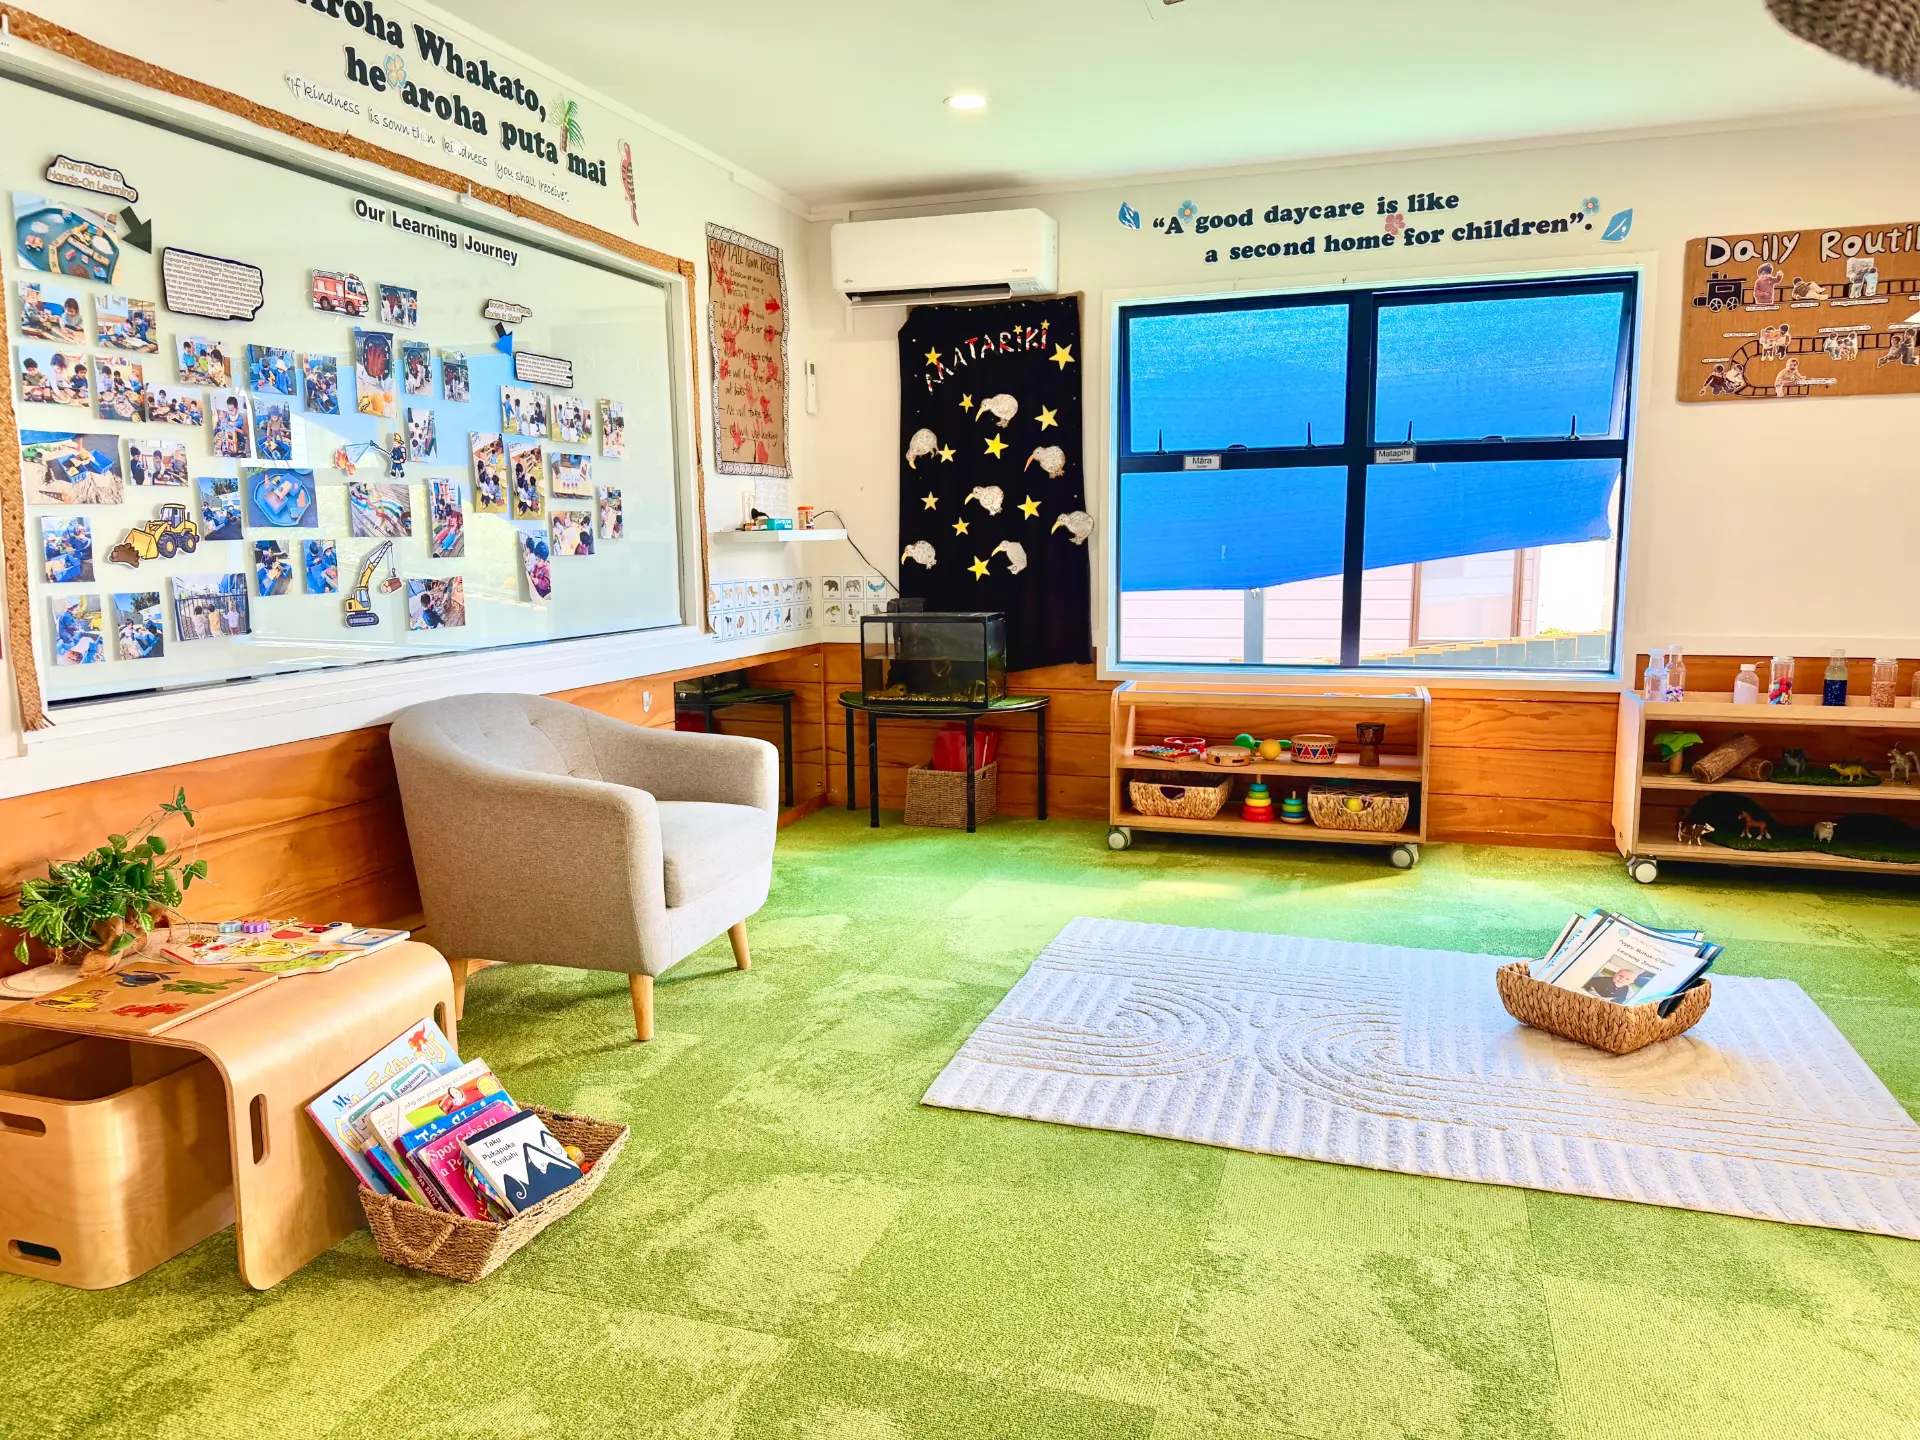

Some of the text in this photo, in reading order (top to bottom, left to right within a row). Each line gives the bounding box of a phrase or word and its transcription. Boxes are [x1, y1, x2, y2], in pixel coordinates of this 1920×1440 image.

[296, 0, 547, 122] roha Whakato,
[345, 46, 607, 187] he aroha puta mai
[303, 82, 360, 115] kindness
[369, 108, 380, 125] is
[382, 117, 410, 135] sown
[443, 137, 488, 167] kidness
[496, 163, 514, 179] you
[515, 170, 536, 188] shall
[58, 158, 122, 182] From Books to
[48, 169, 135, 200] Hands-On Learning
[1195, 208, 1253, 234] good
[1263, 201, 1365, 225] daycare
[1376, 196, 1399, 215] is
[1407, 192, 1460, 213] like
[355, 199, 518, 267] Our Learning Journey
[1204, 249, 1218, 263] a
[1229, 236, 1316, 261] second
[1323, 233, 1395, 253] home
[1403, 227, 1445, 246] for
[1704, 232, 1800, 267] Daily
[1378, 449, 1411, 459] Matapihi
[1619, 939, 1634, 951] Poppy
[1617, 947, 1664, 972] Learning Journey
[333, 1093, 351, 1111] My
[428, 1143, 457, 1163] Spot
[484, 1118, 497, 1129] to
[481, 1142, 516, 1160] Pukapuka
[483, 1137, 501, 1149] Taku
[491, 1151, 519, 1167] Tualahi
[440, 1168, 450, 1177] a
[425, 1187, 439, 1205] Shiny
